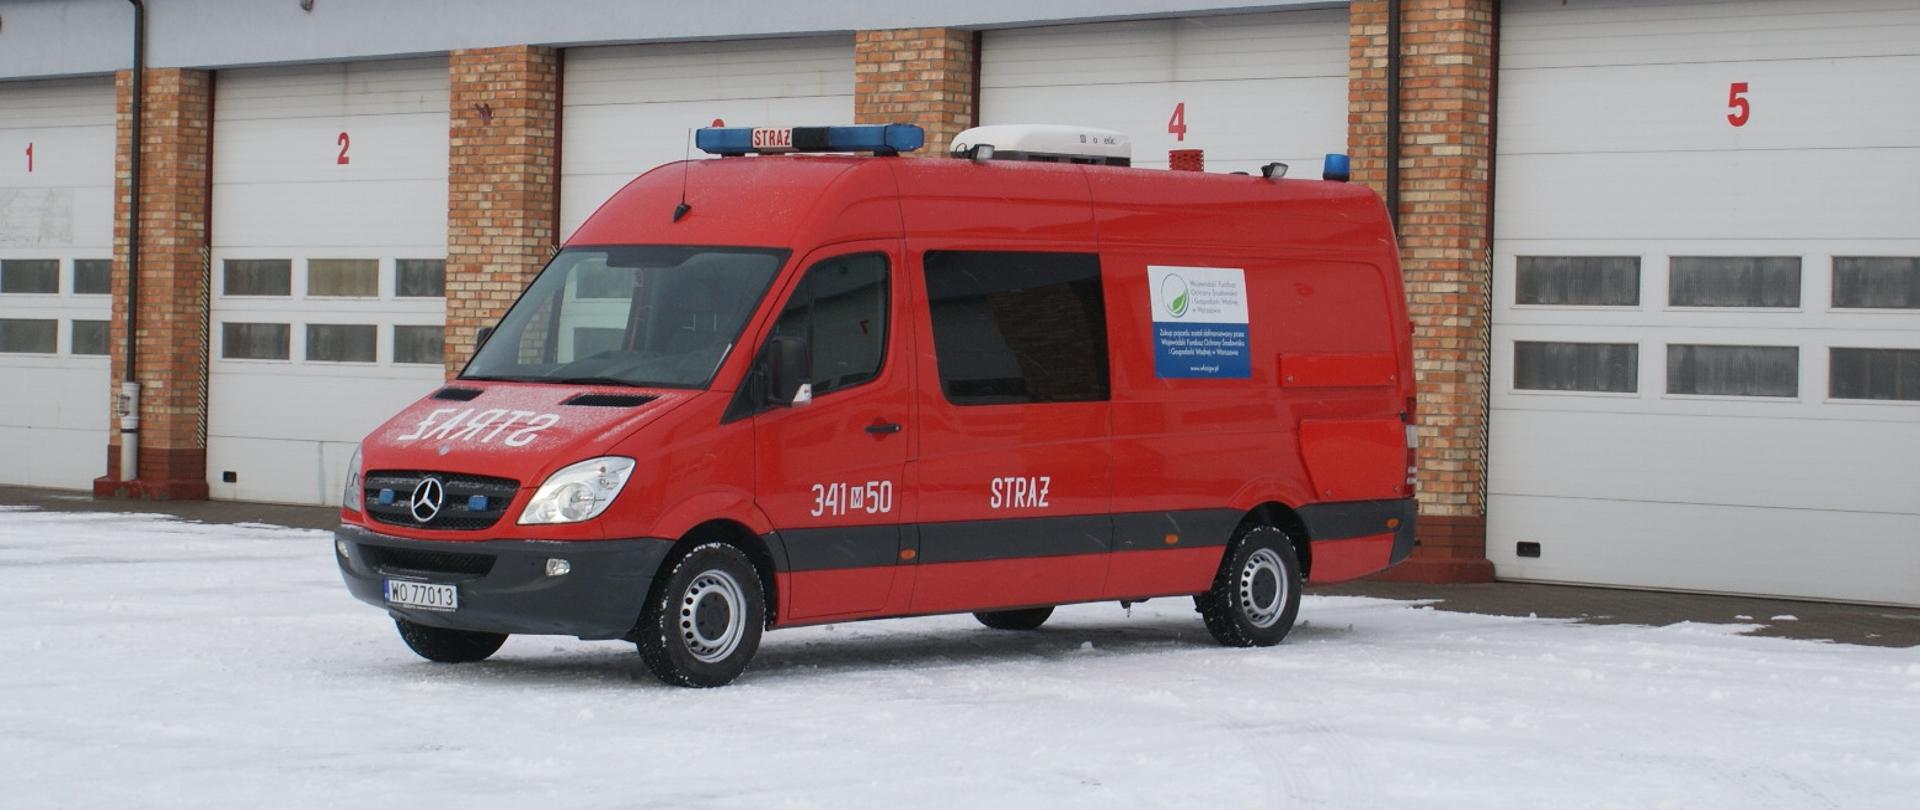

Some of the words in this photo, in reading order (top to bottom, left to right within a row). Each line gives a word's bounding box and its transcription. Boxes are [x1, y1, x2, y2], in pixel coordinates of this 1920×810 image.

[1727, 82, 1750, 127] 5
[1168, 102, 1187, 141] 4
[26, 142, 33, 172] 1
[337, 132, 350, 165] 2
[391, 582, 408, 602] WO
[411, 584, 453, 606] 77013
